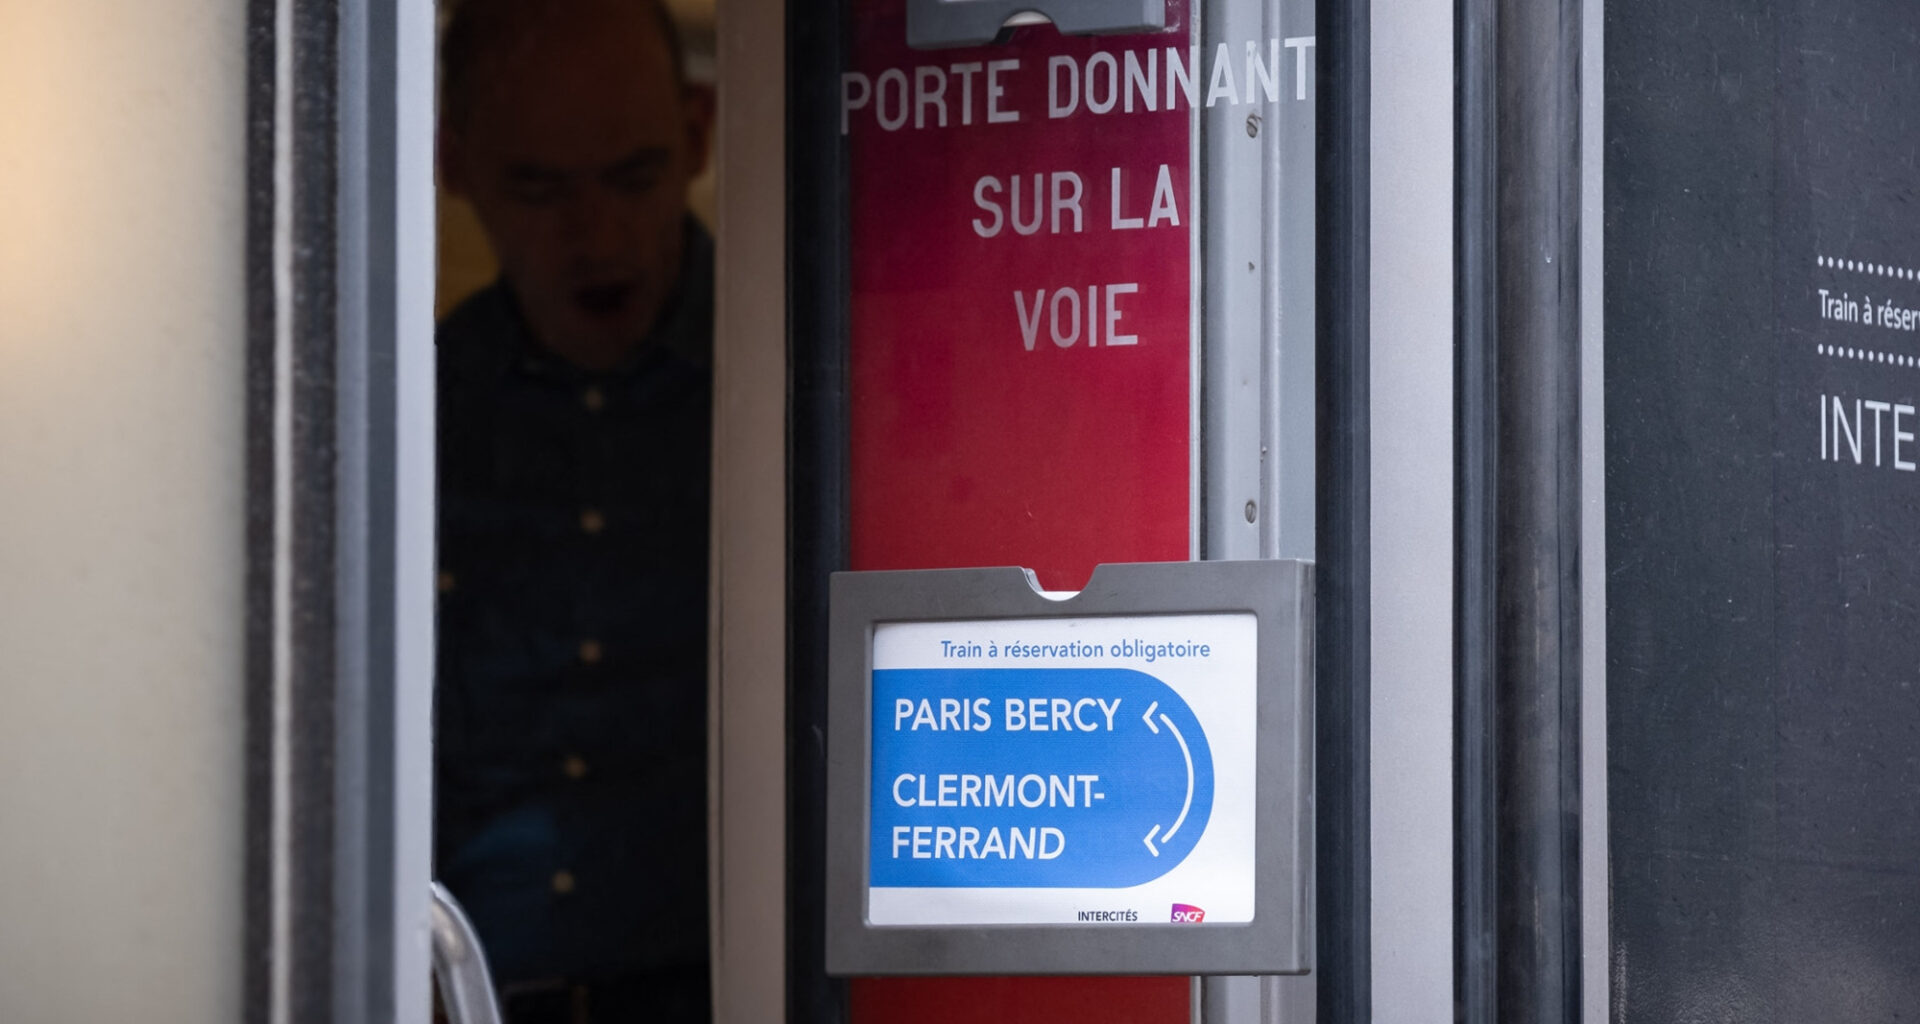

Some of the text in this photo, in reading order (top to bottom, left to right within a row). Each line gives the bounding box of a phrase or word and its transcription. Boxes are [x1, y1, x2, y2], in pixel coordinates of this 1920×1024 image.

[841, 36, 1316, 135] PORTE DONNANT
[972, 164, 1180, 238] SUR LA
[1013, 283, 1138, 351] VOIE
[1818, 289, 1920, 331] Train à réser
[1820, 394, 1916, 471] INTE
[941, 638, 1211, 662] Train à réservation obligatoire
[894, 698, 1122, 731] PARIS BERCY
[892, 774, 1105, 808] CLERMONT-
[892, 826, 1066, 860] FERRAND
[1077, 909, 1138, 922] INTERCITÉS
[1172, 911, 1203, 922] SNCF
